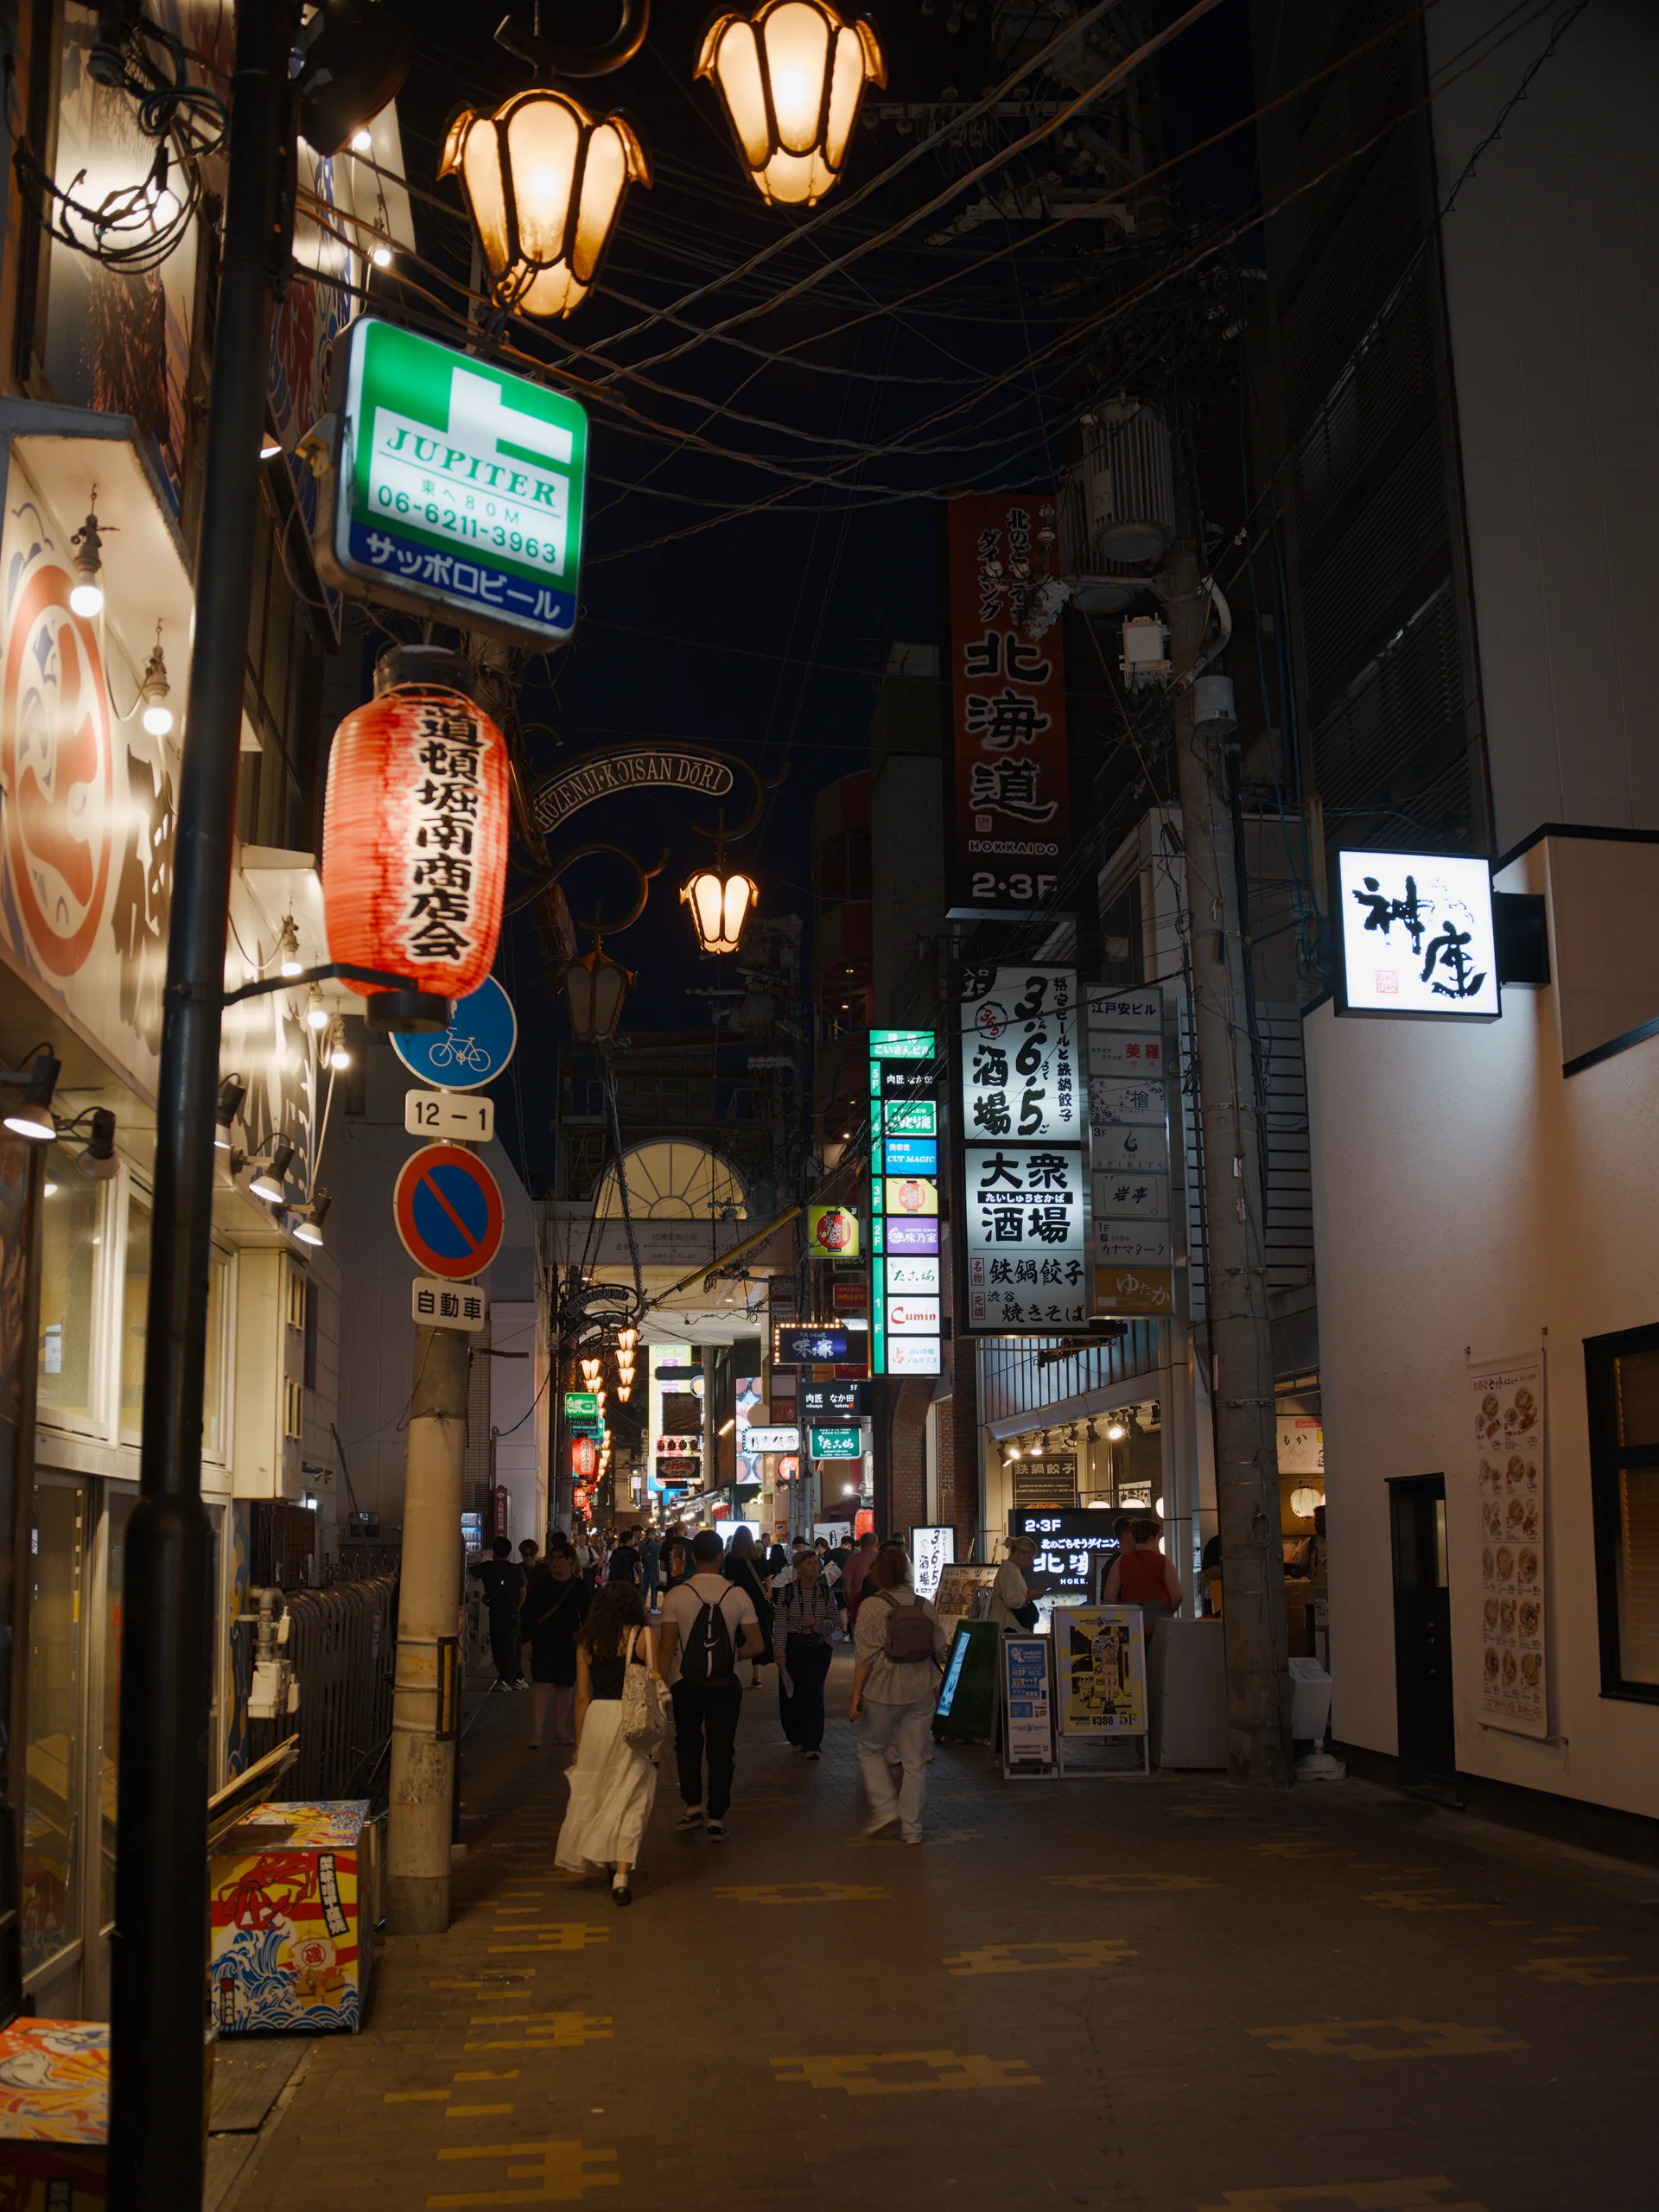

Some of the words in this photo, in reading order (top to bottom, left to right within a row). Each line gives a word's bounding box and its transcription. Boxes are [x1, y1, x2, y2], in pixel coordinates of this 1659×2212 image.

[387, 427, 556, 508] JUPITER
[377, 484, 556, 565] 06-6211-3963
[366, 531, 562, 620] サッポロビール
[964, 631, 1058, 824] 北海道
[407, 703, 486, 960] 道頓堀南商店会
[968, 840, 1059, 856] HOKKAIDO
[963, 969, 989, 978] 入口
[1092, 1002, 1156, 1015] 江戸安ビル
[874, 1045, 931, 1056] こいさんビル
[872, 1069, 879, 1089] 5F
[887, 1074, 905, 1084] 肉匠
[973, 1044, 1012, 1136] 酒場
[1130, 1090, 1150, 1108] 檜
[1094, 1128, 1107, 1138] 3F
[887, 1154, 904, 1163] CUT
[905, 1154, 936, 1163] MAGIC
[1096, 1160, 1163, 1169] SPIRITS
[980, 1152, 1070, 1190] 大衆
[874, 1186, 880, 1206] 3F
[985, 1192, 1066, 1204] たいしゅうさかば
[1112, 1185, 1148, 1204] 岩亭
[982, 1207, 1071, 1244] 酒場
[1098, 1223, 1111, 1232] 1F
[874, 1225, 881, 1246] 2F
[905, 1232, 937, 1243] 味乃家
[972, 1261, 983, 1285] 名物
[988, 1258, 1085, 1287] 鉄鍋餃子
[988, 1290, 1016, 1303] 渋谷
[1116, 1273, 1171, 1306] ゆたか
[417, 1290, 482, 1321] 自動車
[973, 1295, 985, 1318] 元祖
[1001, 1302, 1086, 1324] 焼きそば
[890, 1306, 937, 1325] Cumin
[805, 1393, 823, 1404] 肉匠
[830, 1393, 855, 1403] なか田
[1014, 1463, 1075, 1475] 鉄鍋餃子
[1033, 1550, 1090, 1576] 北海
[1092, 1716, 1114, 1726] ¥380
[1120, 1712, 1137, 1726] 5F
